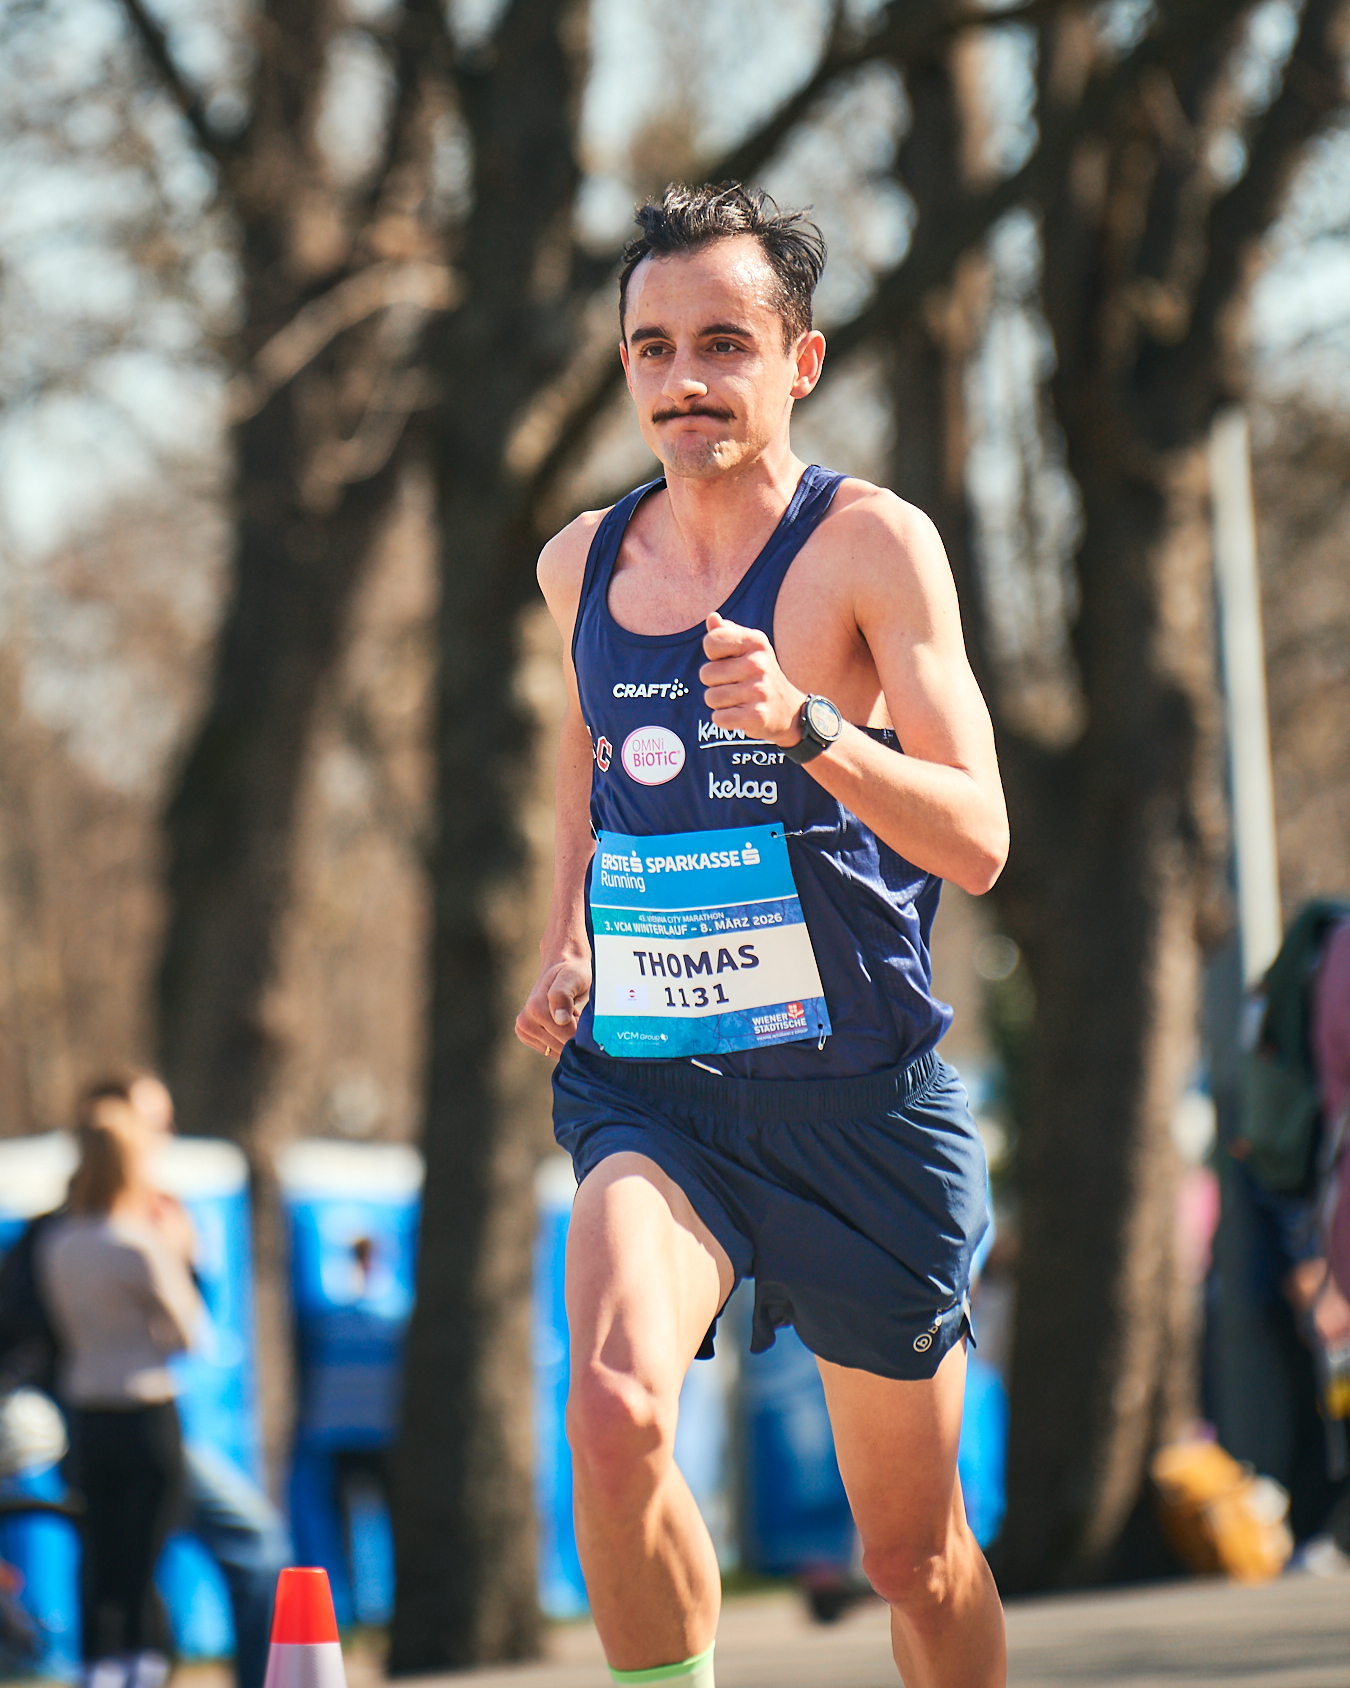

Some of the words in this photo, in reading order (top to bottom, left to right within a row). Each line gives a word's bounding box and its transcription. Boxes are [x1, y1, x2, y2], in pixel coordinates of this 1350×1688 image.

[612, 683, 671, 698] CRAFT
[632, 738, 664, 752] OMNi
[731, 750, 786, 766] SPORT
[709, 772, 777, 804] kelag
[601, 852, 631, 873] ERSTE
[645, 850, 741, 874] SPARKASSE
[601, 870, 646, 893] Running
[604, 920, 614, 931] 3.
[613, 921, 633, 933] VCM
[632, 922, 688, 936] WINTERLAUF
[700, 923, 713, 933] 8.
[714, 917, 751, 931] MÄRZ
[752, 913, 783, 926] 2026
[682, 912, 725, 924] MARATHON
[633, 944, 760, 979] THOMAS
[664, 983, 730, 1008] 1131
[752, 1013, 788, 1025] WIENER
[616, 1031, 639, 1040] VCM
